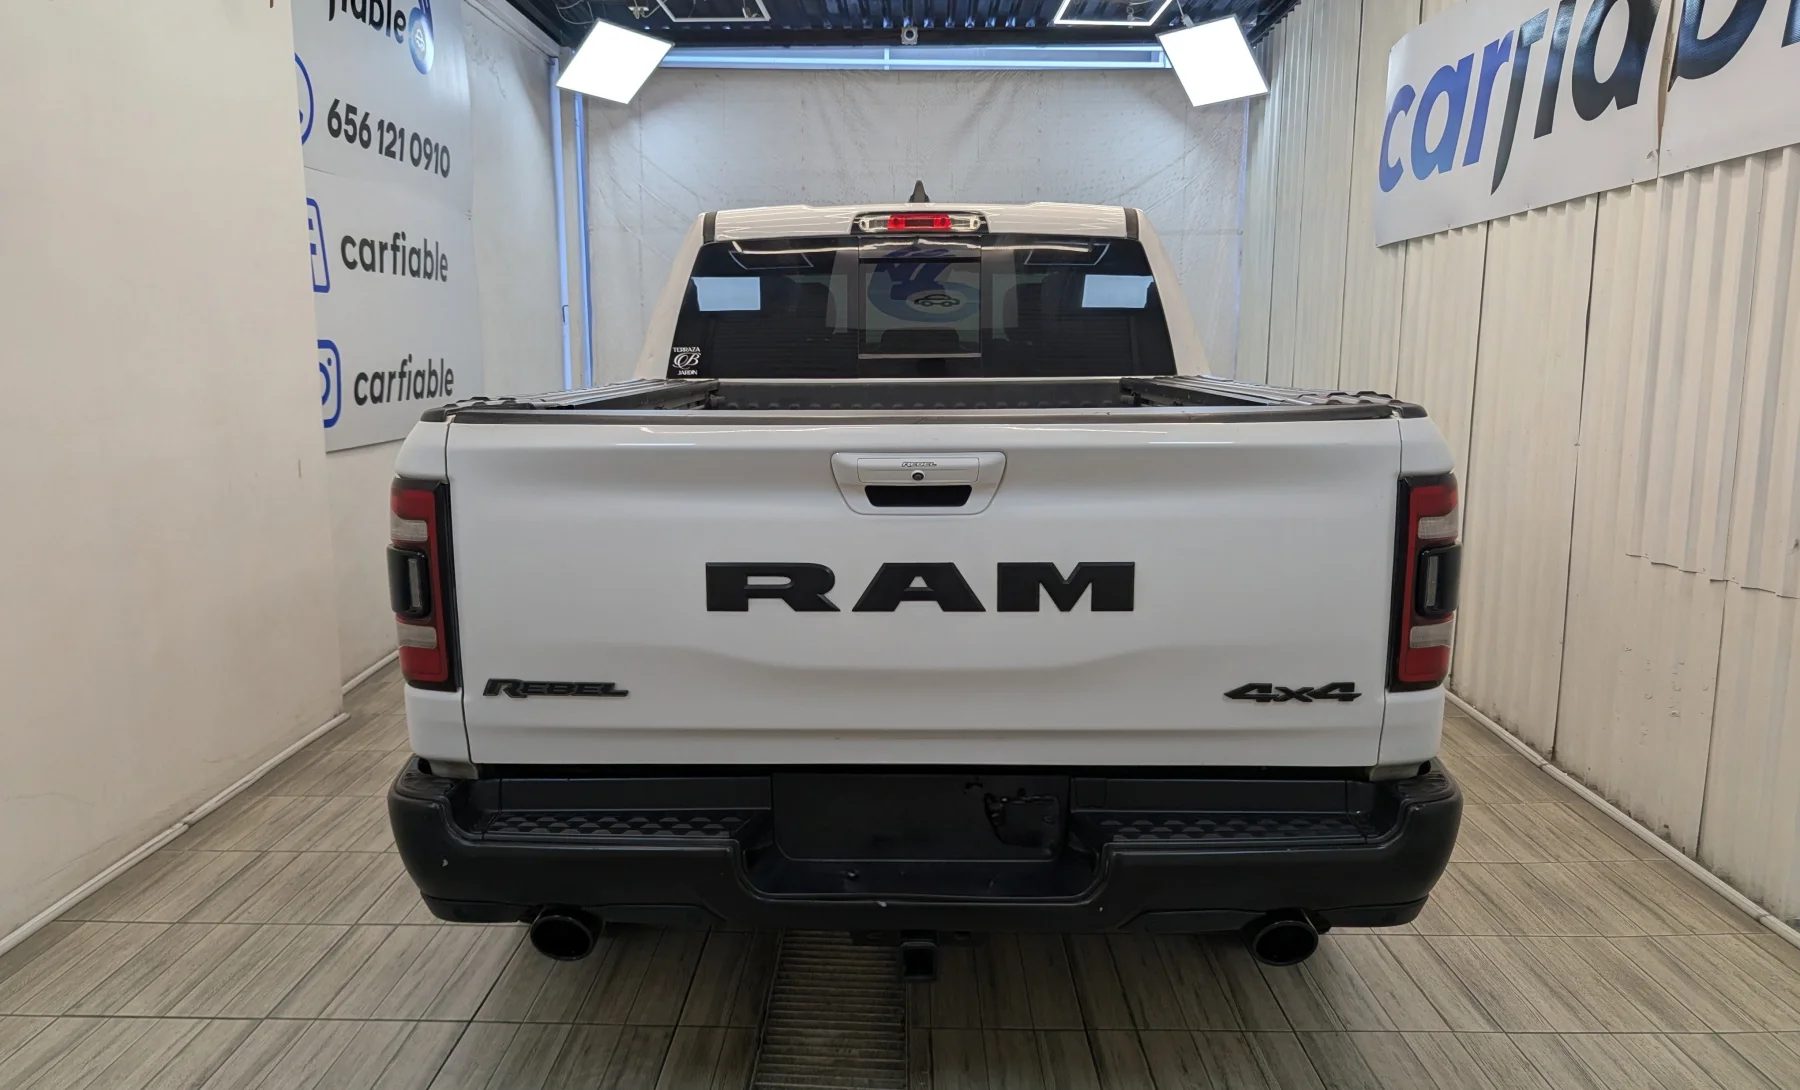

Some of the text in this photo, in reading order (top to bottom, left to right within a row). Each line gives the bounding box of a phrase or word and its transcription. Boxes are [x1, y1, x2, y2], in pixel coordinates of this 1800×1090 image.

[328, 0, 407, 44] able
[327, 98, 451, 178] 656 121 0910
[340, 231, 448, 282] carfiable
[354, 353, 455, 406] carfiable
[705, 562, 1135, 612] RAM
[483, 678, 630, 699] REBEL
[1223, 681, 1363, 702] 4x4
